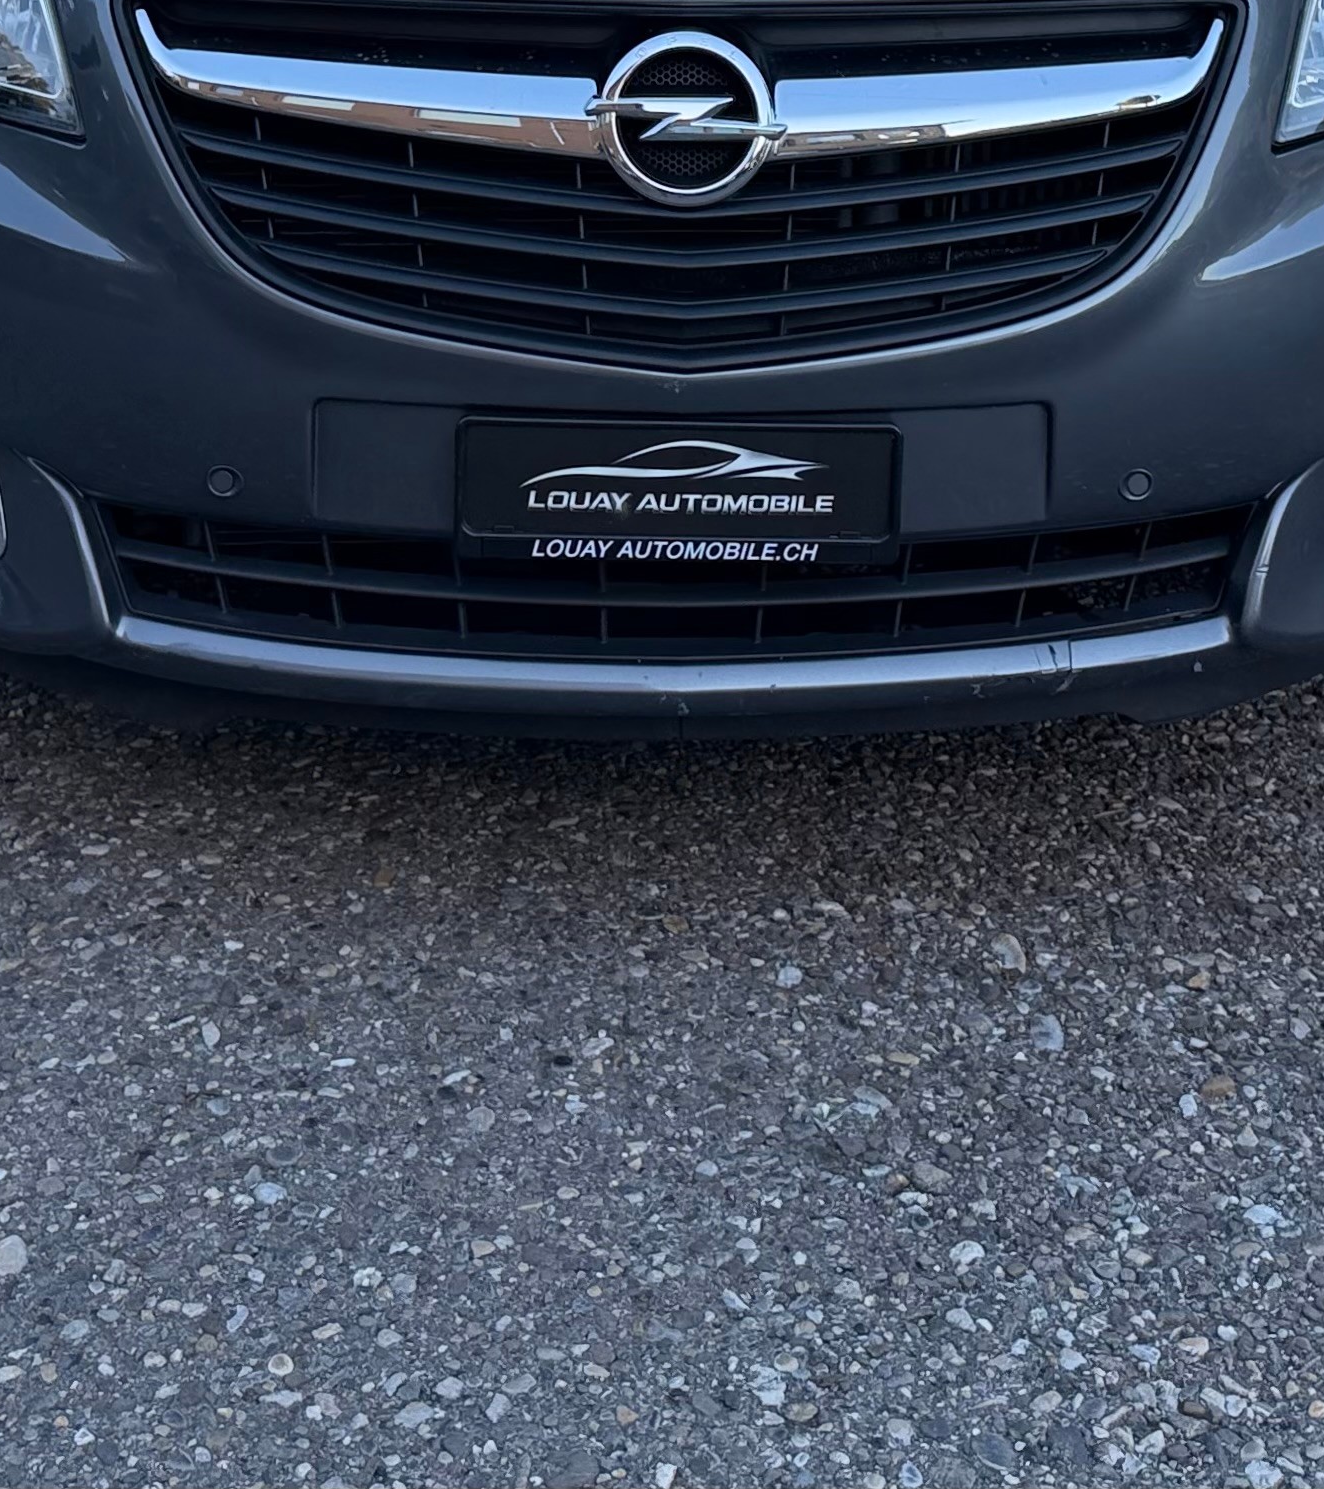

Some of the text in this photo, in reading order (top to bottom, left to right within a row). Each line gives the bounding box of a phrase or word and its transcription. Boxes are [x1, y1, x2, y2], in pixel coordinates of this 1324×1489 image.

[527, 490, 835, 514] LOUAY AUTOMOBILE
[531, 538, 819, 561] LOUAY AUTOMOBILE.CH
